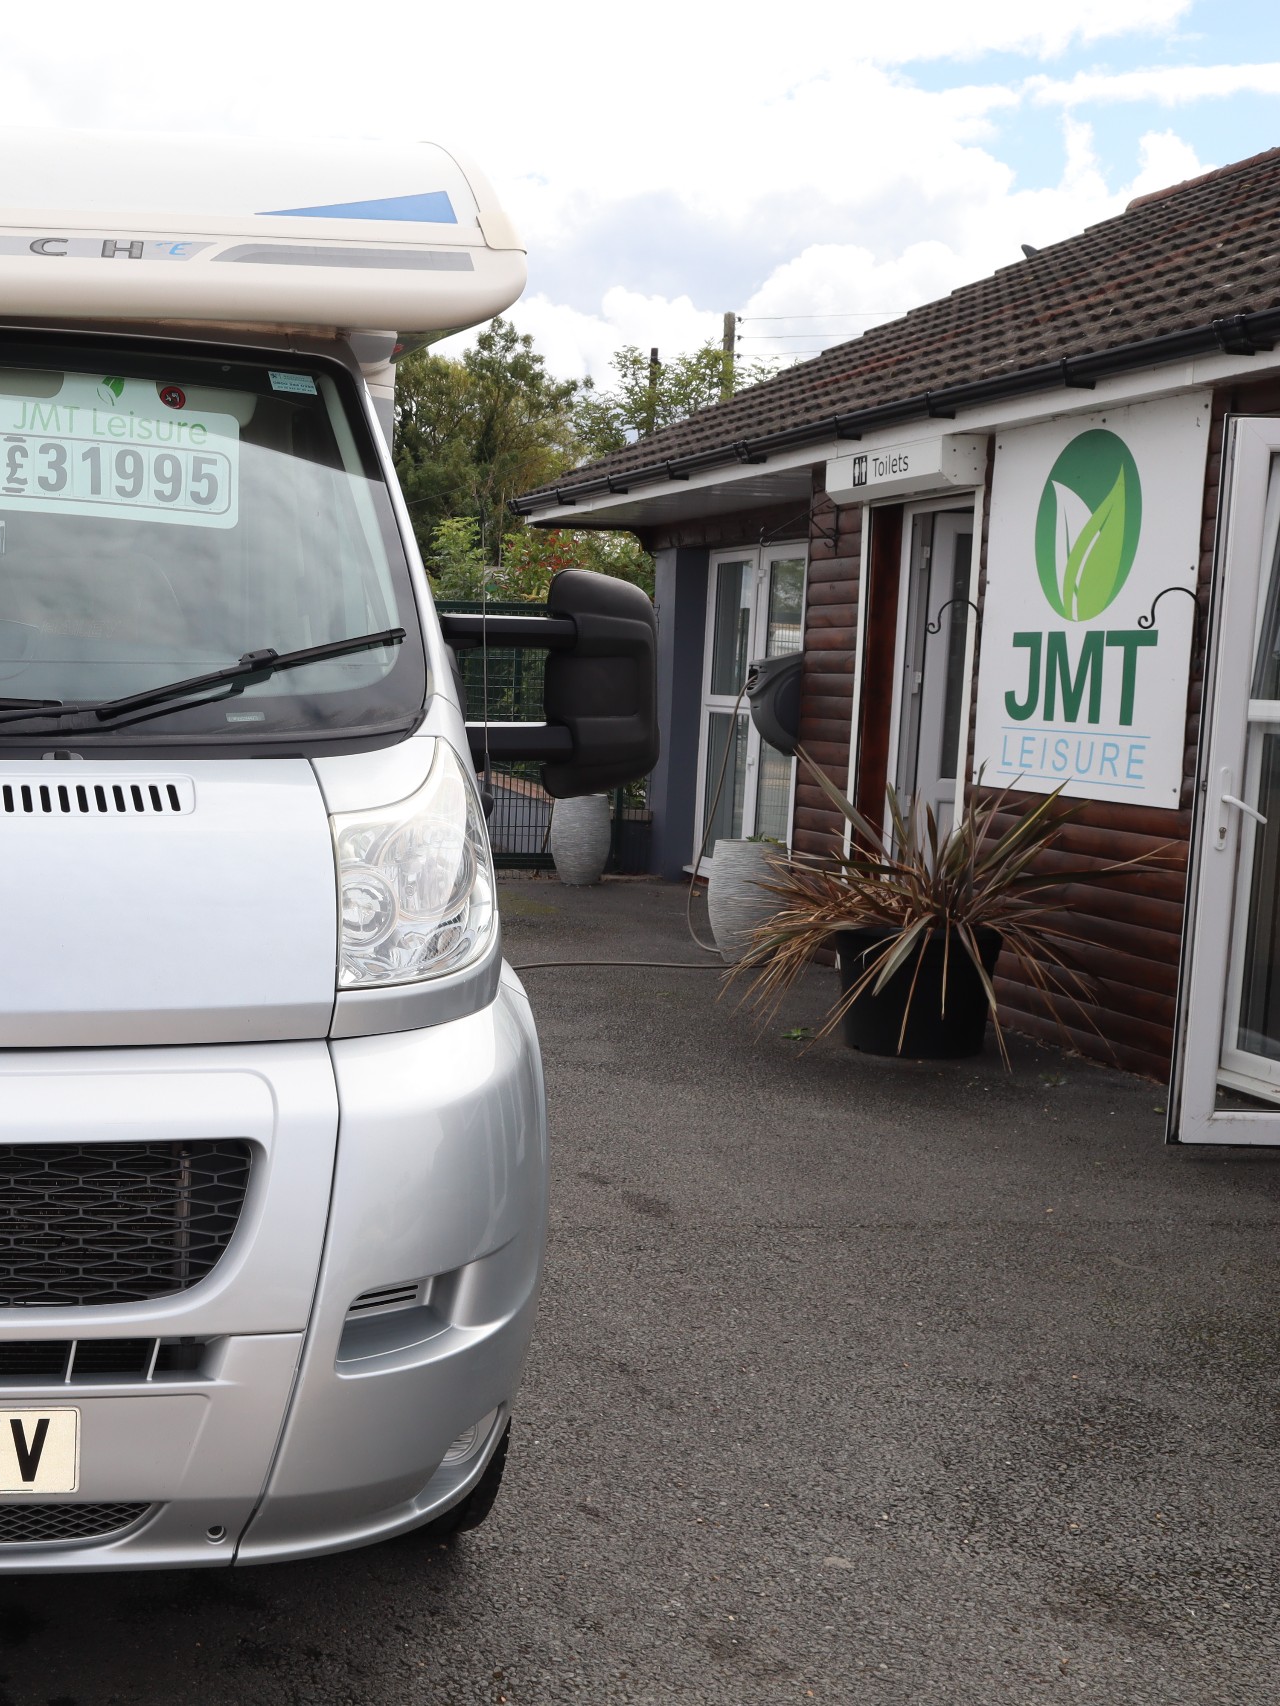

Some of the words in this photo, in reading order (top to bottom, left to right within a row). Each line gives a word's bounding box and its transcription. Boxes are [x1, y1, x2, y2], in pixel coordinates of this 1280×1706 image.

[13, 402, 80, 434] JMT
[92, 408, 208, 445] Leisure
[2, 436, 219, 506] £31995
[872, 453, 909, 478] Toilets
[1004, 629, 1159, 726] JMT
[1001, 735, 1146, 780] LEISURE
